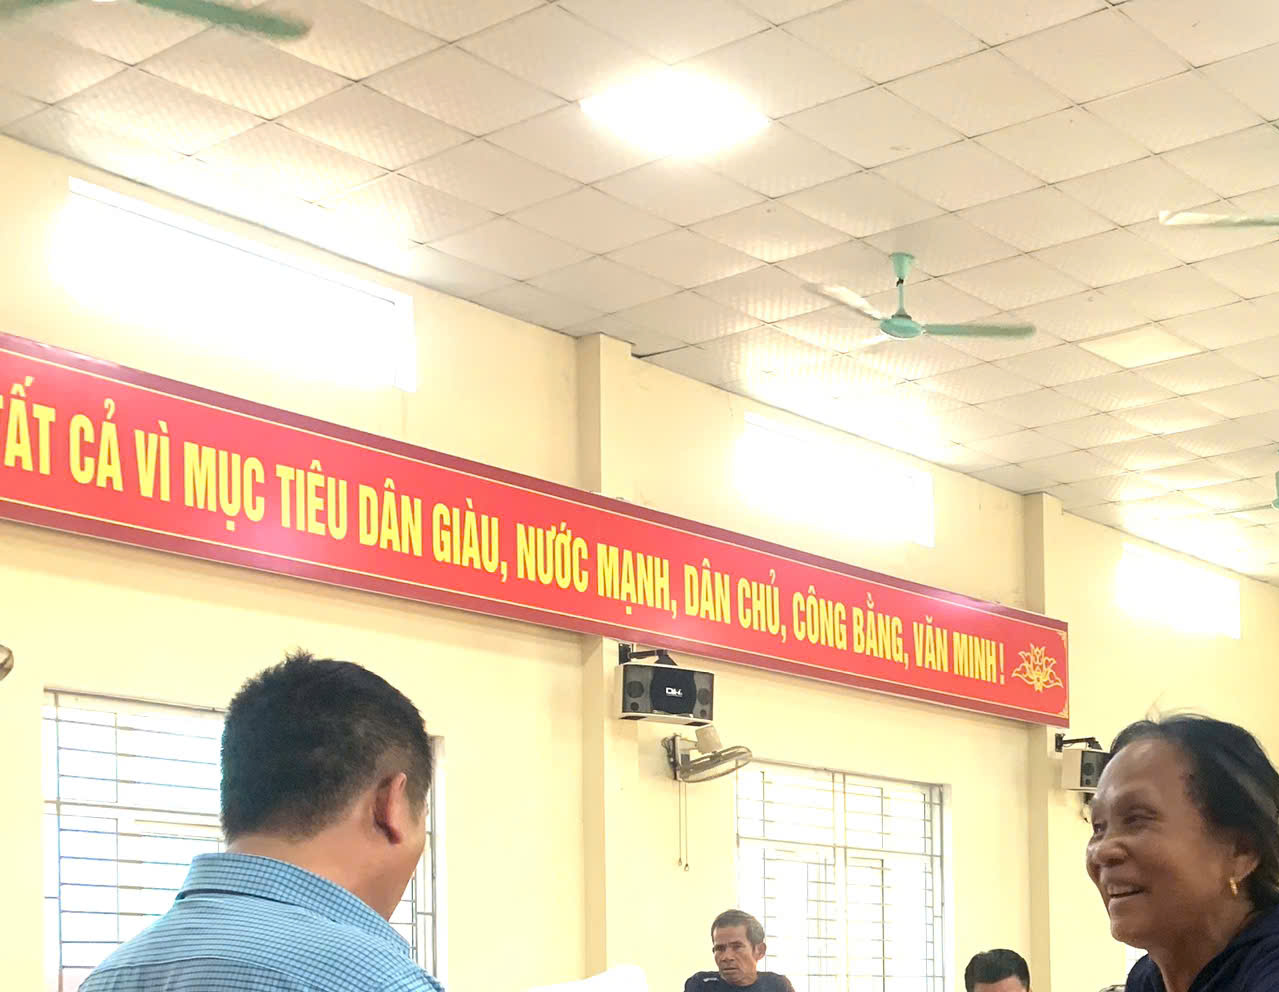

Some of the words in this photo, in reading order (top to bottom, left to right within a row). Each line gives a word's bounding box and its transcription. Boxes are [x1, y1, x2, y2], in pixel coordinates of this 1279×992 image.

[0, 375, 57, 476] ẤT
[69, 398, 124, 492] CẢ
[134, 419, 171, 504] VÌ
[183, 441, 265, 532] MỤC
[275, 459, 348, 541] TIÊU
[358, 477, 423, 558] DÂN
[432, 497, 508, 583] GIÀU,
[516, 520, 589, 593] NƯỚC
[596, 543, 678, 617] MẠNH,
[683, 556, 732, 626] DÂN
[737, 568, 787, 643] CHỦ,
[791, 585, 848, 651] CÔNG
[852, 591, 909, 670] BẰNG,
[912, 619, 949, 674] VĂN
